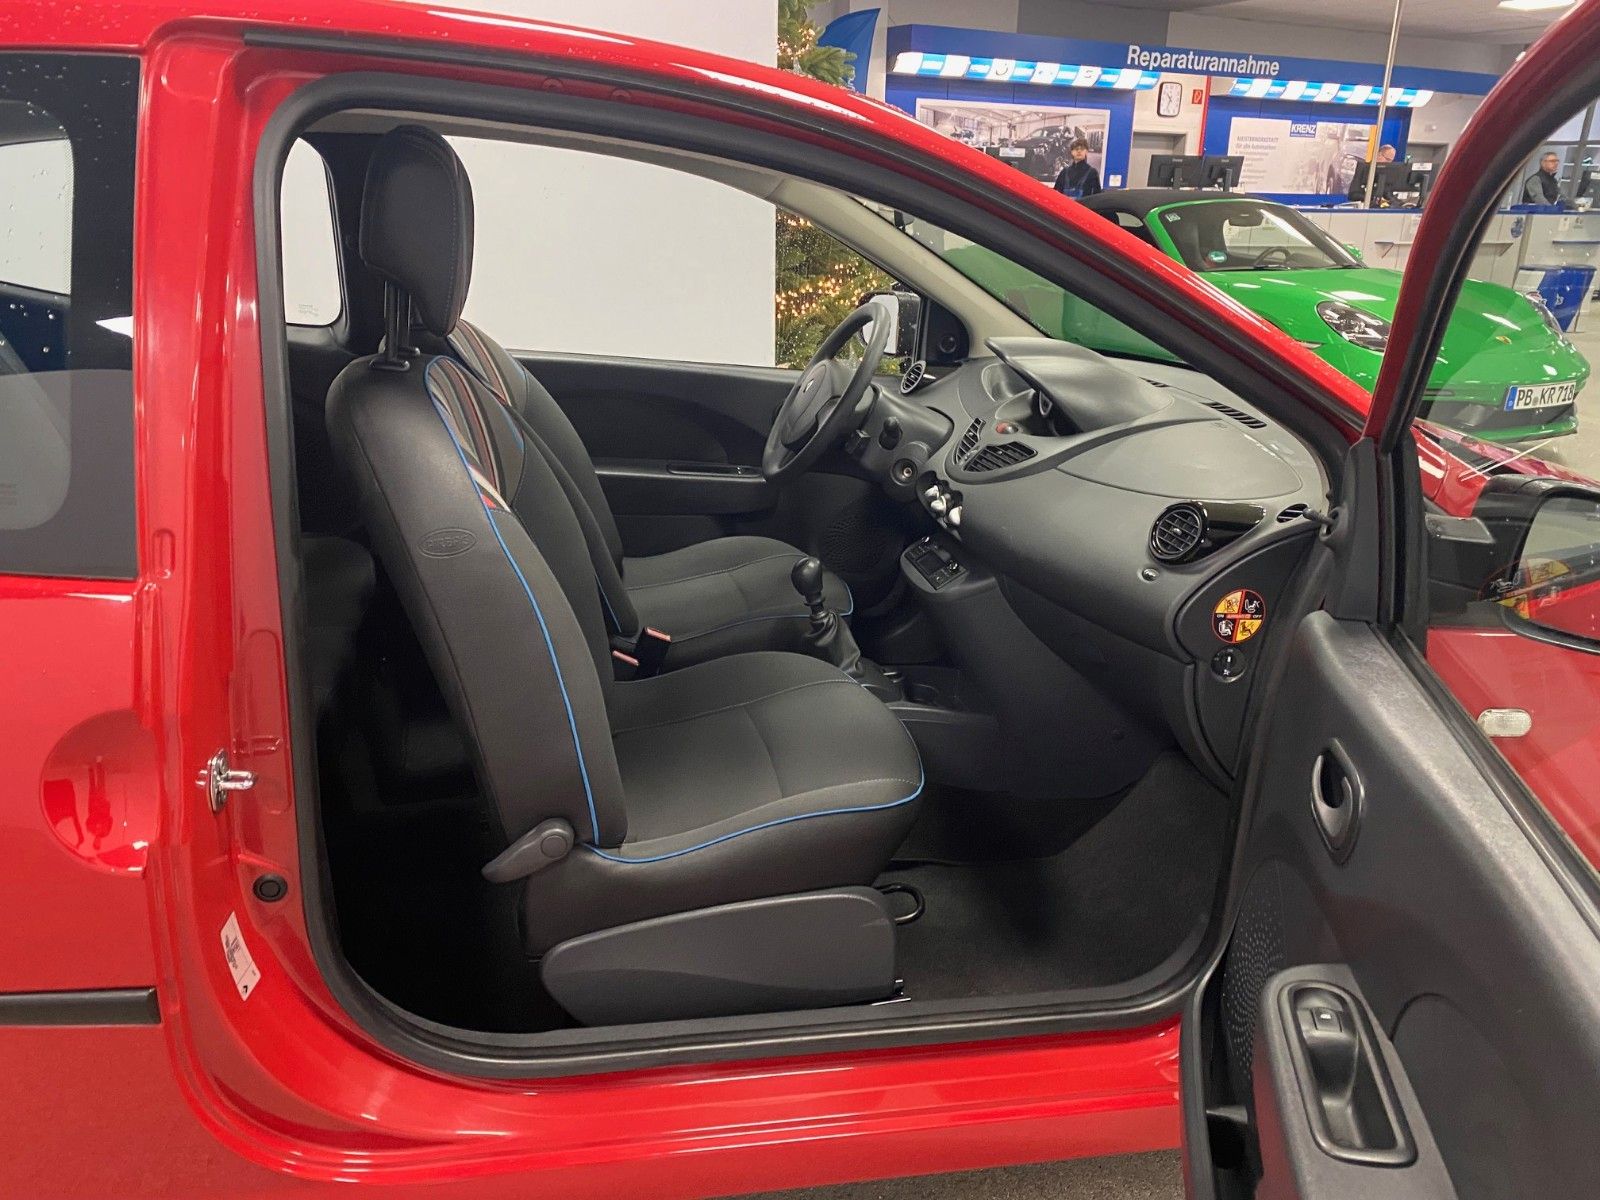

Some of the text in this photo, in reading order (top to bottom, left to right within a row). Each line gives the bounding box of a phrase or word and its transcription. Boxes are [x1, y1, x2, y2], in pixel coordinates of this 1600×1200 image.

[1127, 45, 1280, 76] Reparaturannahme
[1291, 124, 1316, 134] KRENZ
[1516, 385, 1574, 406] PB KR 718
